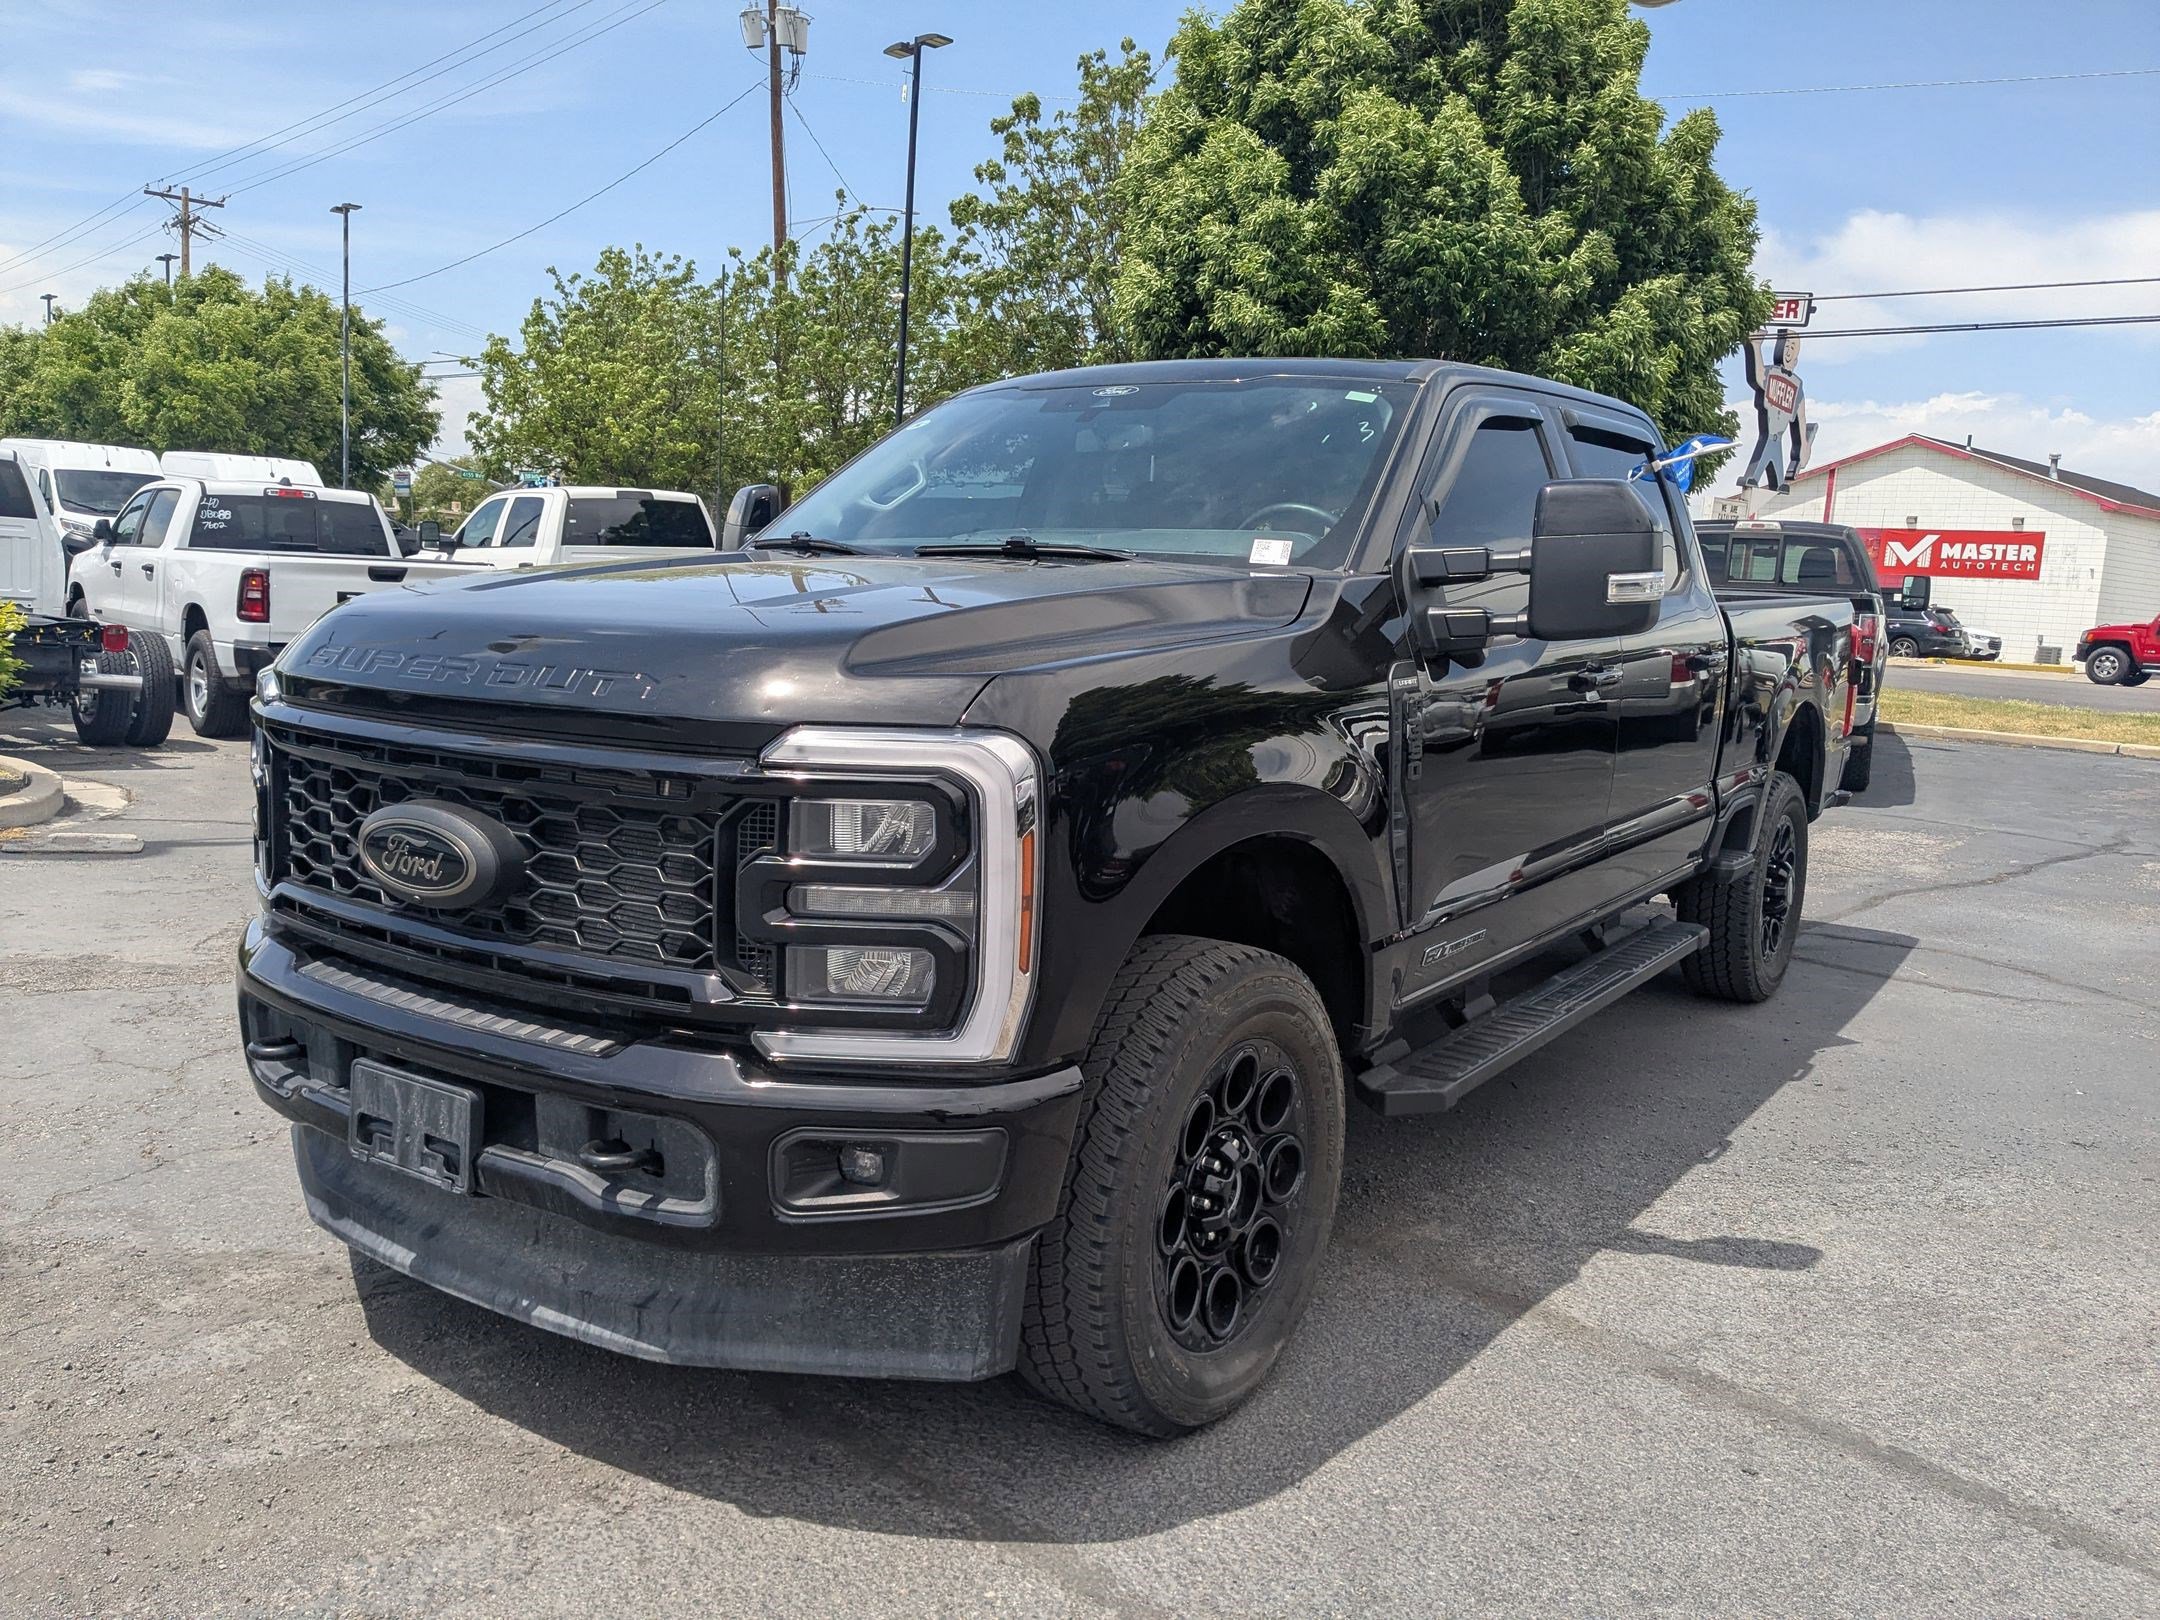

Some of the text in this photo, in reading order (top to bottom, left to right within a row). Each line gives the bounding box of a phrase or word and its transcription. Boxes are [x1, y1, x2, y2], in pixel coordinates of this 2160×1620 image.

[1769, 377, 1795, 409] MUFFLER
[1722, 504, 1739, 514] WE ARE
[202, 521, 228, 530] 7602
[1940, 542, 2038, 562] MASTER
[1940, 561, 2036, 572] AUTOTECH
[305, 646, 687, 699] SUPER DUTY
[382, 833, 445, 882] Ford
